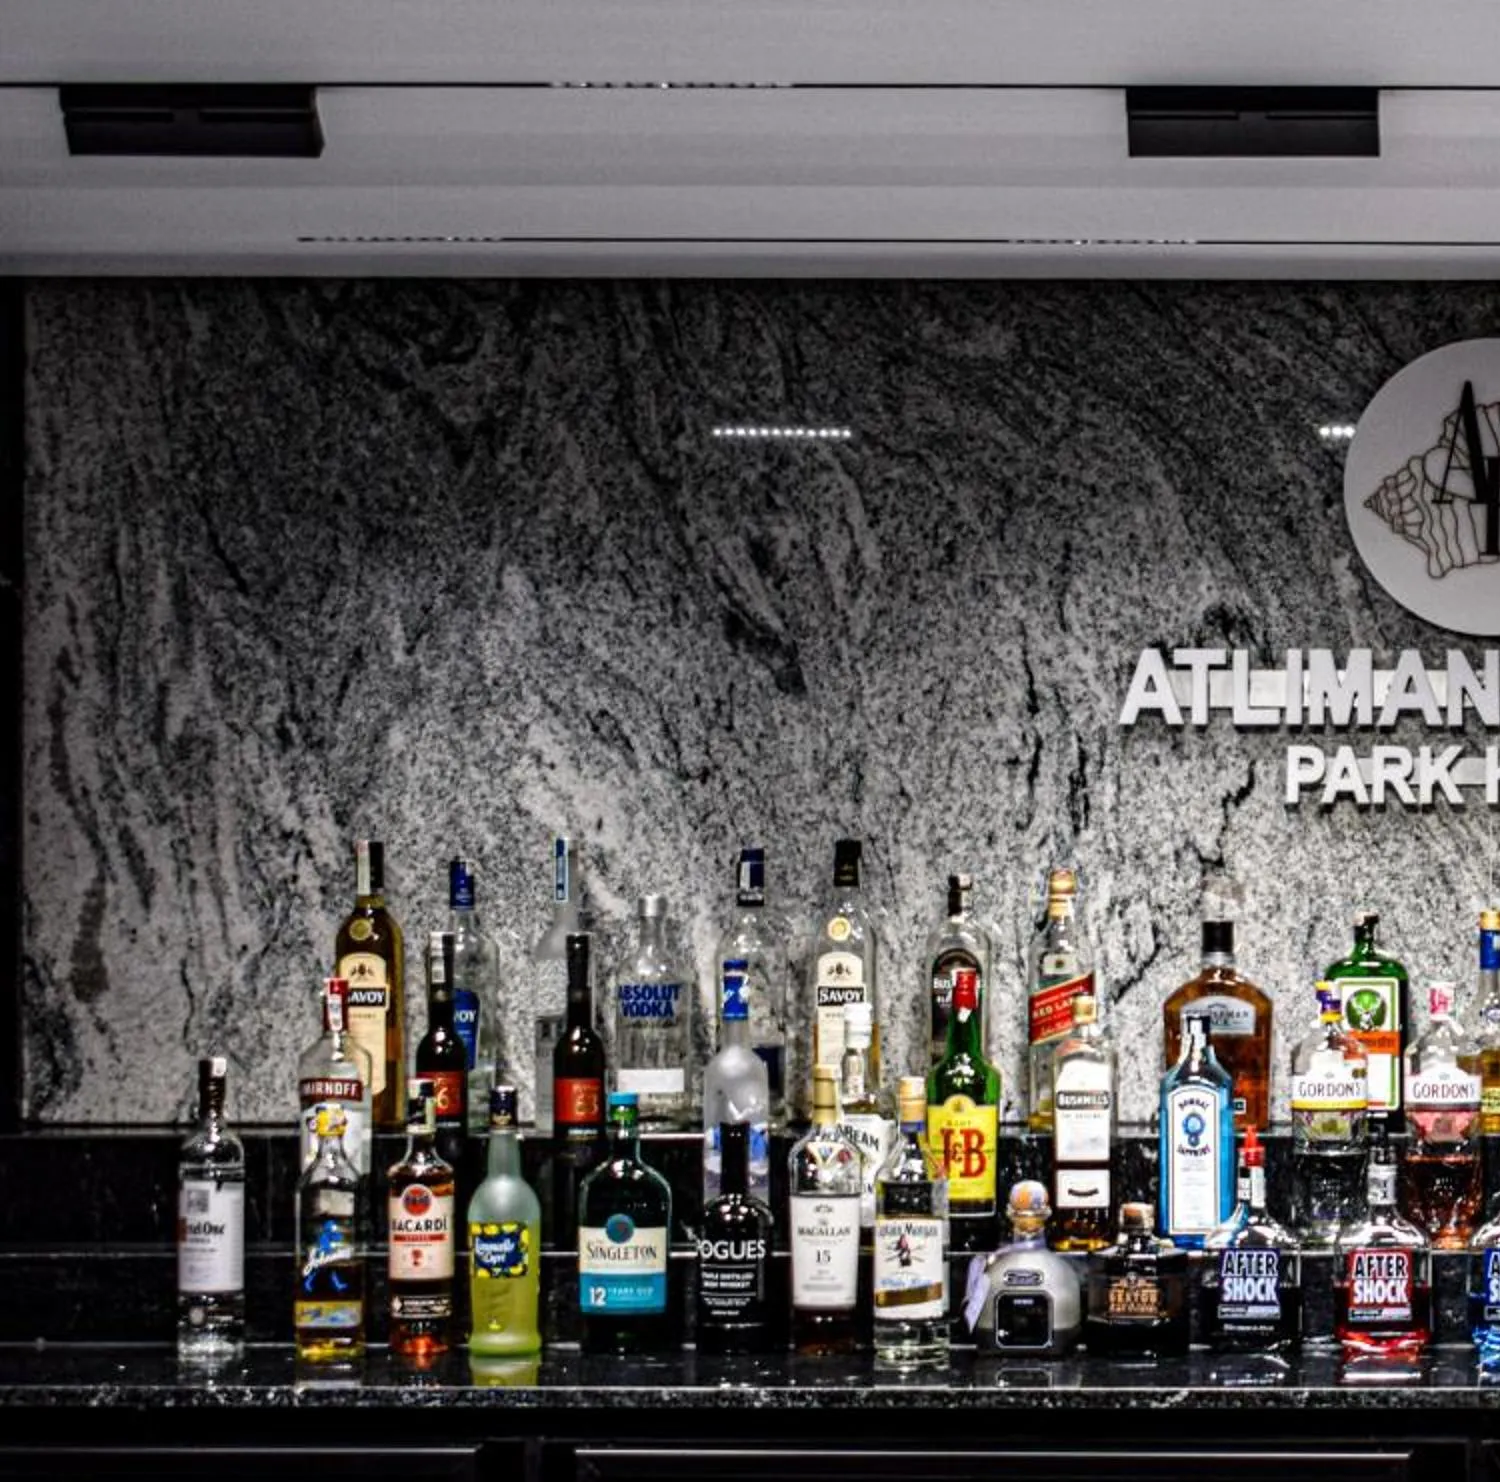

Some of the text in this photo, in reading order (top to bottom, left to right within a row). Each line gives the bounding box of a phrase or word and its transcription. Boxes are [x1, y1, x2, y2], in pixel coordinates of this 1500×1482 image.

[1286, 745, 1463, 805] PARK
[347, 991, 384, 1003] AVOY
[618, 984, 681, 1001] ABSOLUT
[818, 988, 864, 1003] SAVOY
[622, 1001, 675, 1018] VODKA
[941, 1128, 987, 1178] J&B
[816, 1250, 831, 1264] 15
[1221, 1248, 1279, 1278] AFTER
[1352, 1251, 1409, 1279] AFTER
[589, 1287, 607, 1306] 12
[1222, 1277, 1280, 1304] SHOCK
[1353, 1278, 1409, 1304] SHOCK
